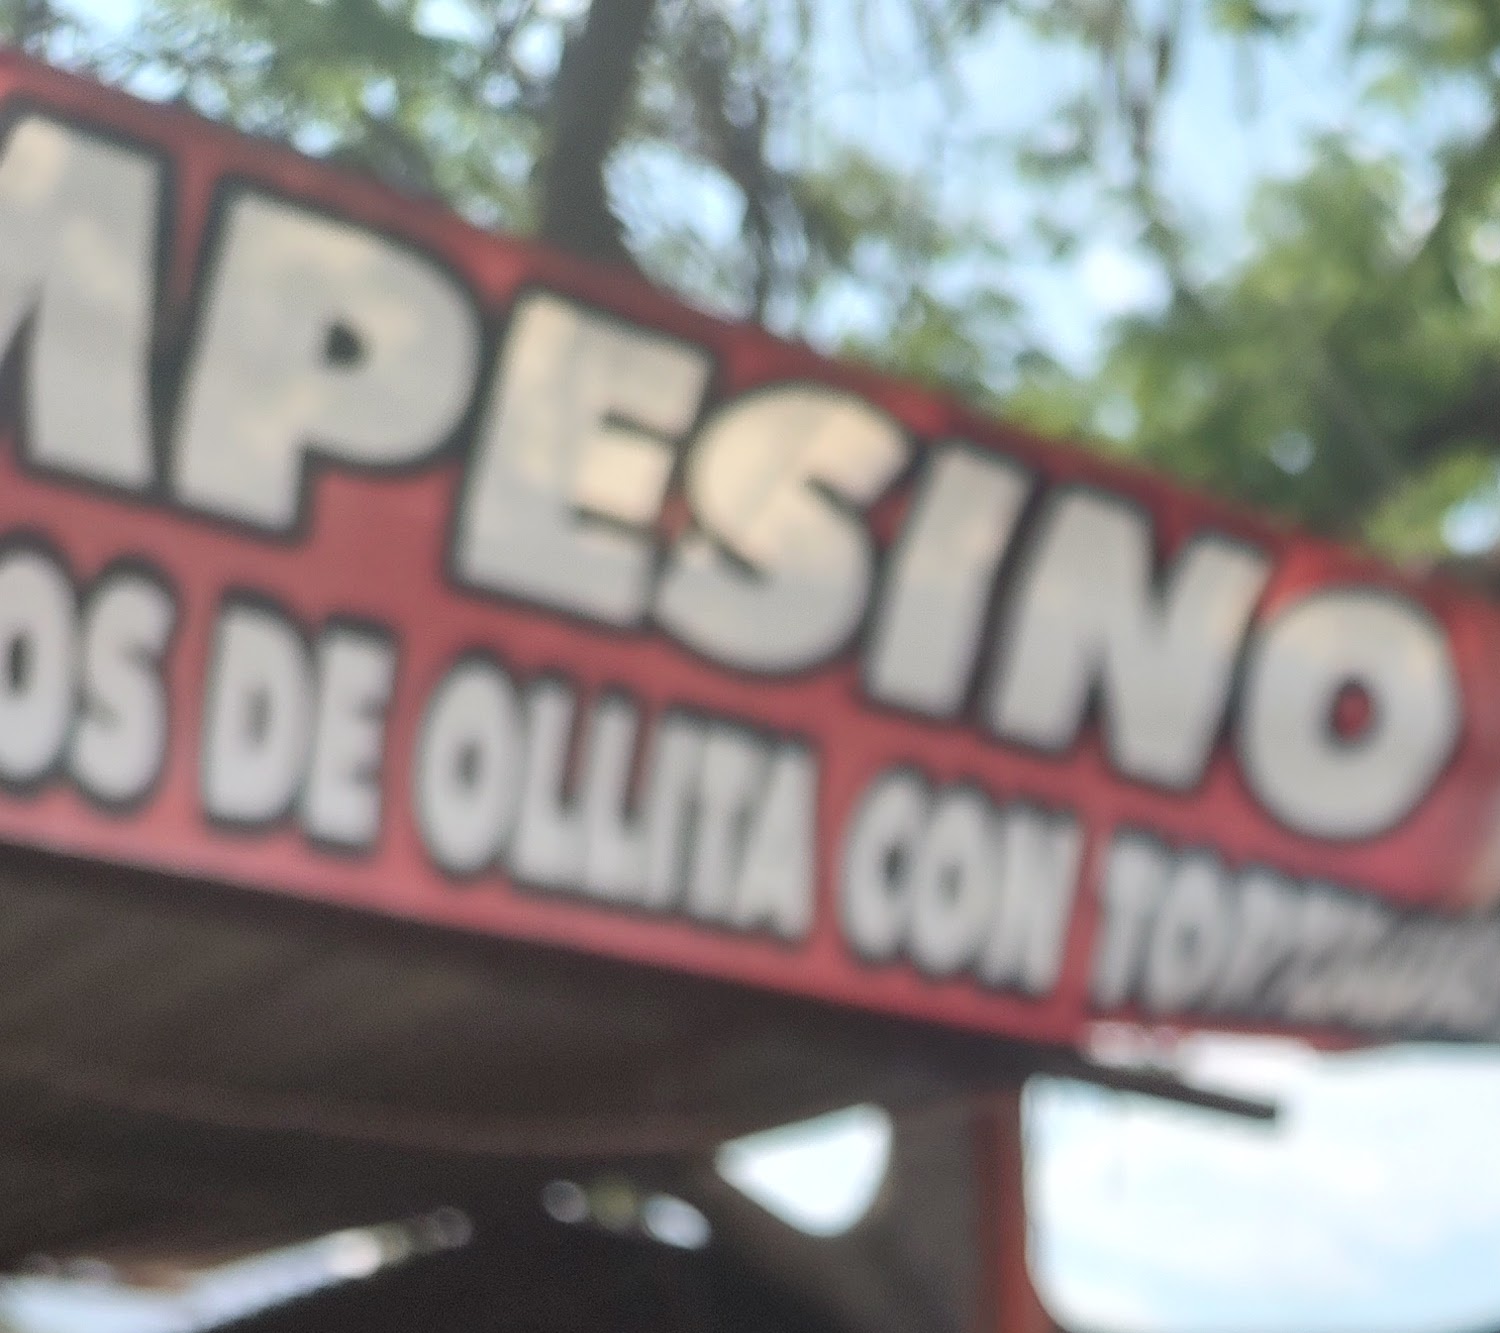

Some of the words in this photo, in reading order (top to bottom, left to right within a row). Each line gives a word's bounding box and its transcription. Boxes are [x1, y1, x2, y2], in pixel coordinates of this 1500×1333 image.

[205, 600, 396, 850] DE
[415, 658, 818, 940] OLLITA
[840, 769, 1084, 995] CON
